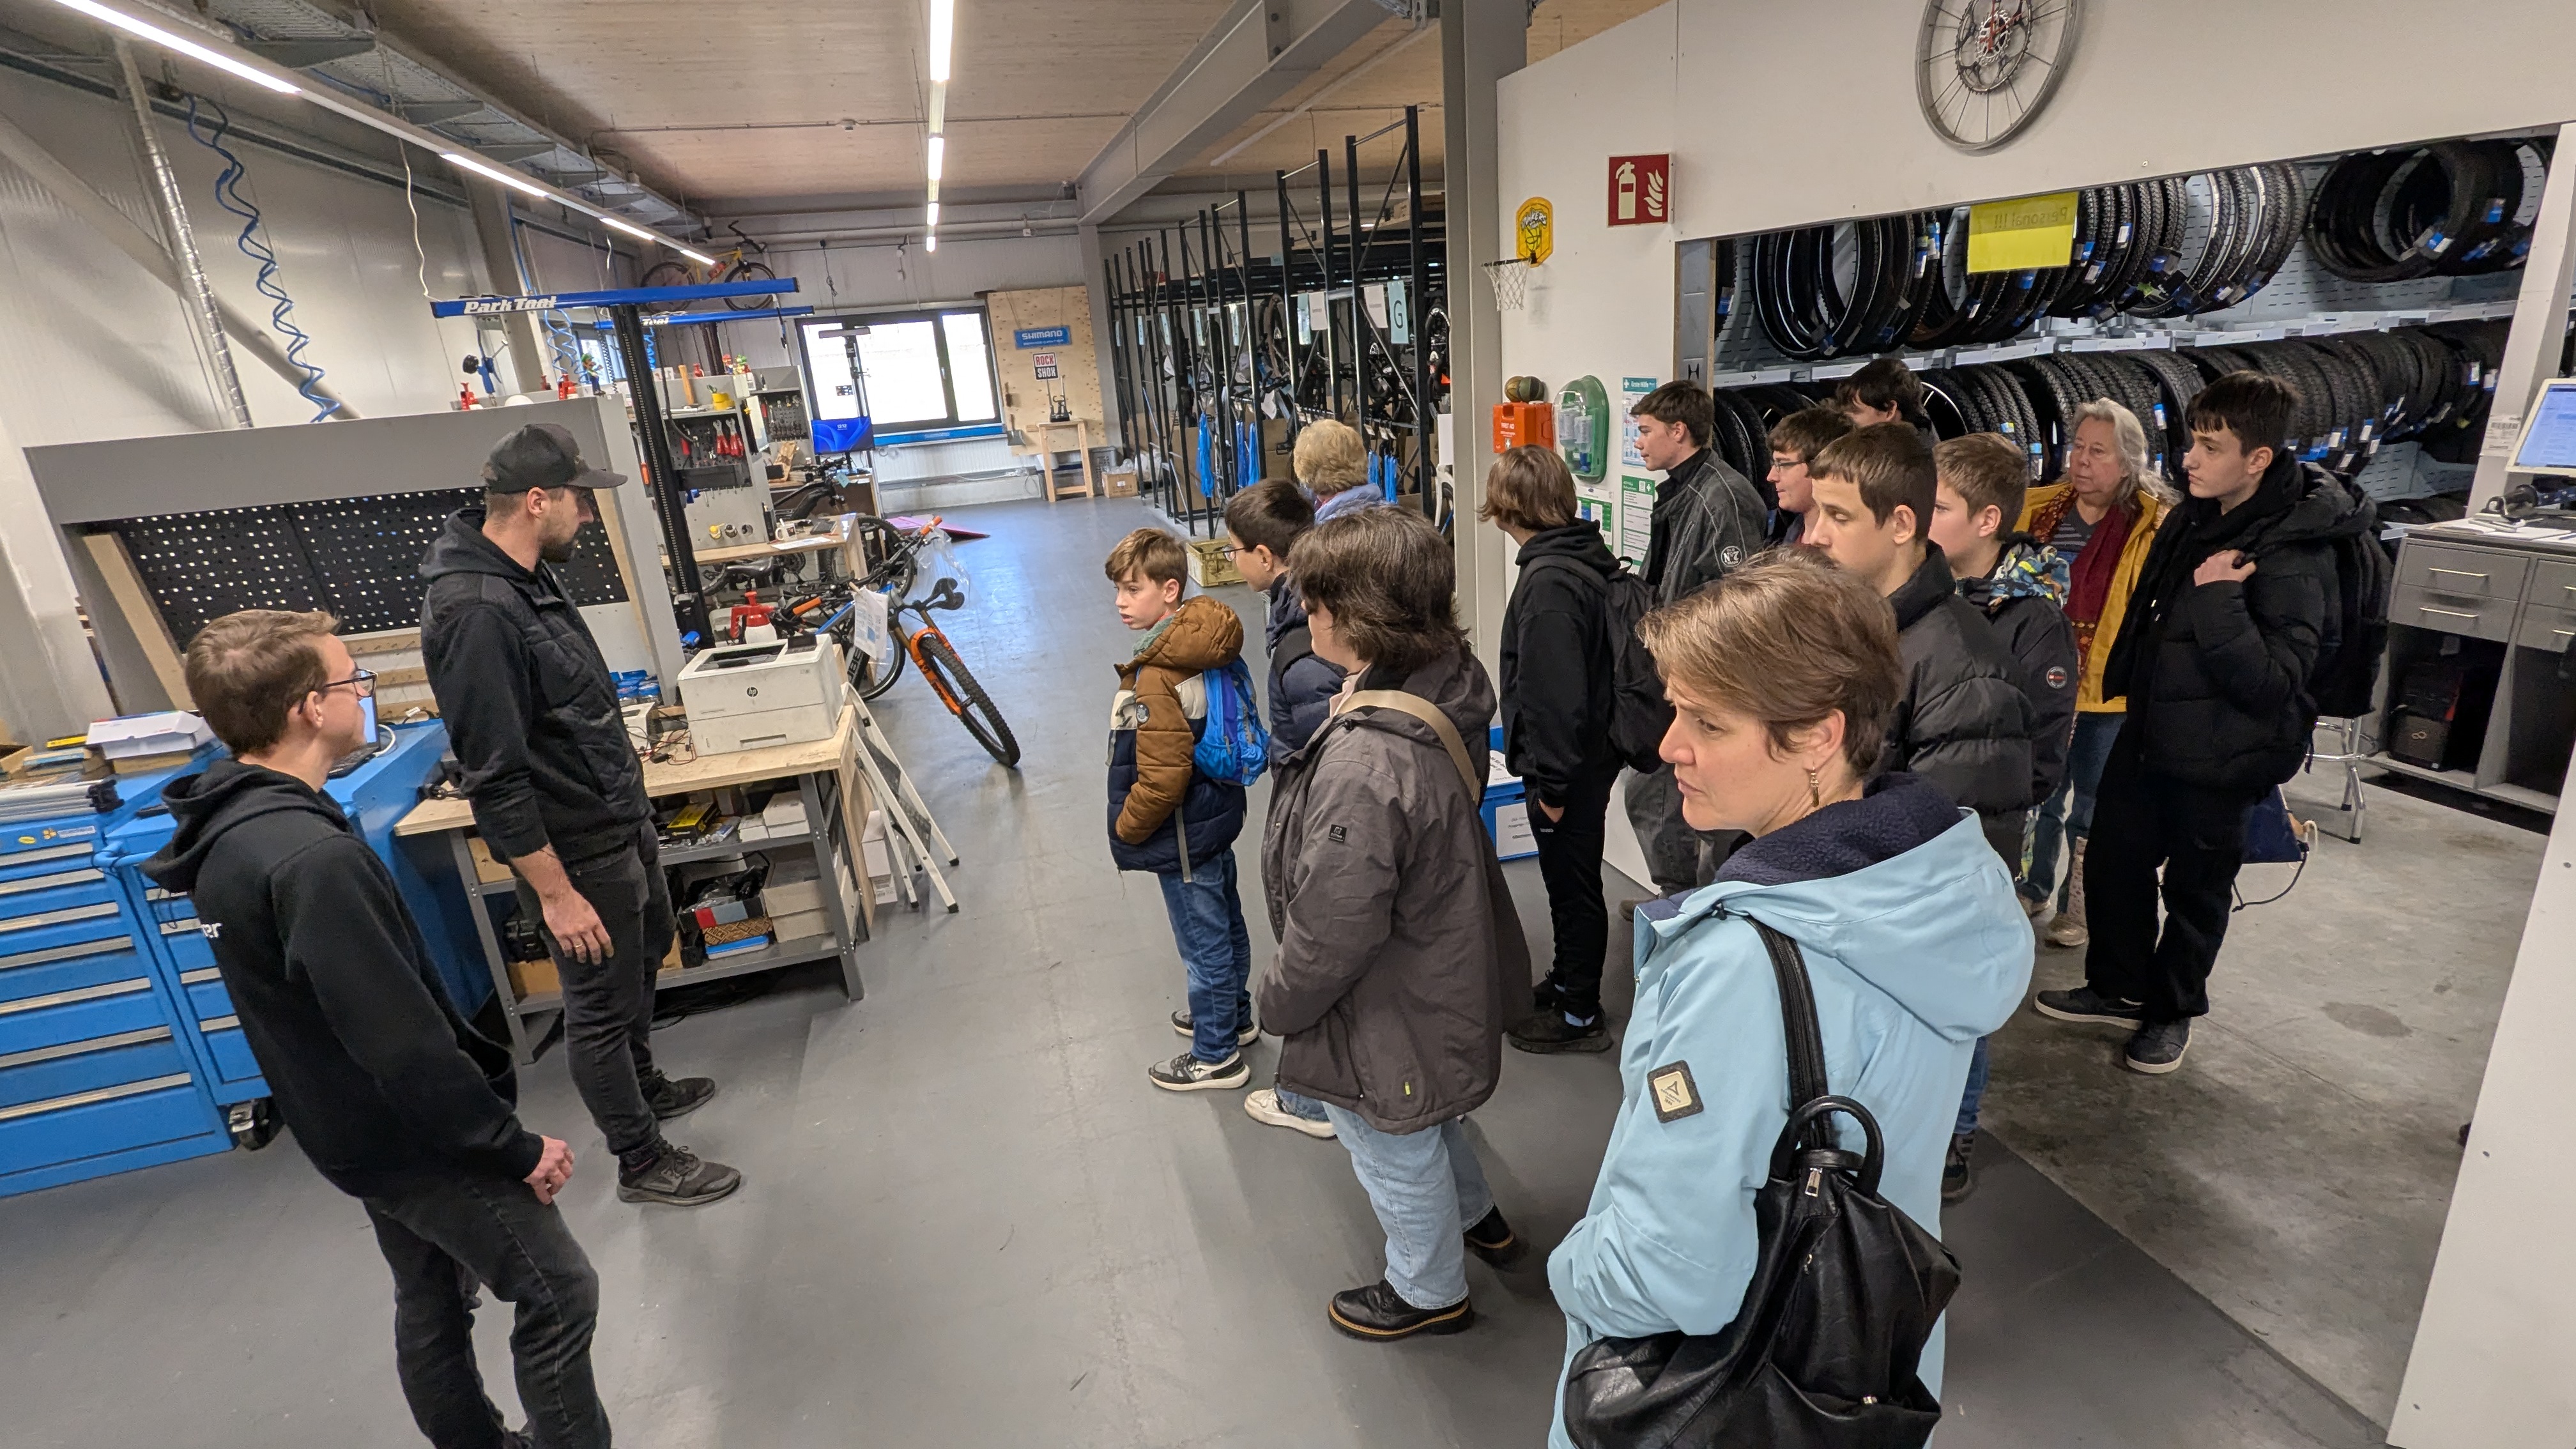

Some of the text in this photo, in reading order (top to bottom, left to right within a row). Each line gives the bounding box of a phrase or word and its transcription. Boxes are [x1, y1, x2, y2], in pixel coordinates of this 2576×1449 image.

[463, 295, 557, 314] Park Tool
[1393, 300, 1404, 329] G
[1022, 330, 1063, 341] SHIMANO
[1035, 355, 1054, 366] ROCK
[1037, 367, 1056, 378] SHOX
[748, 687, 756, 697] hp
